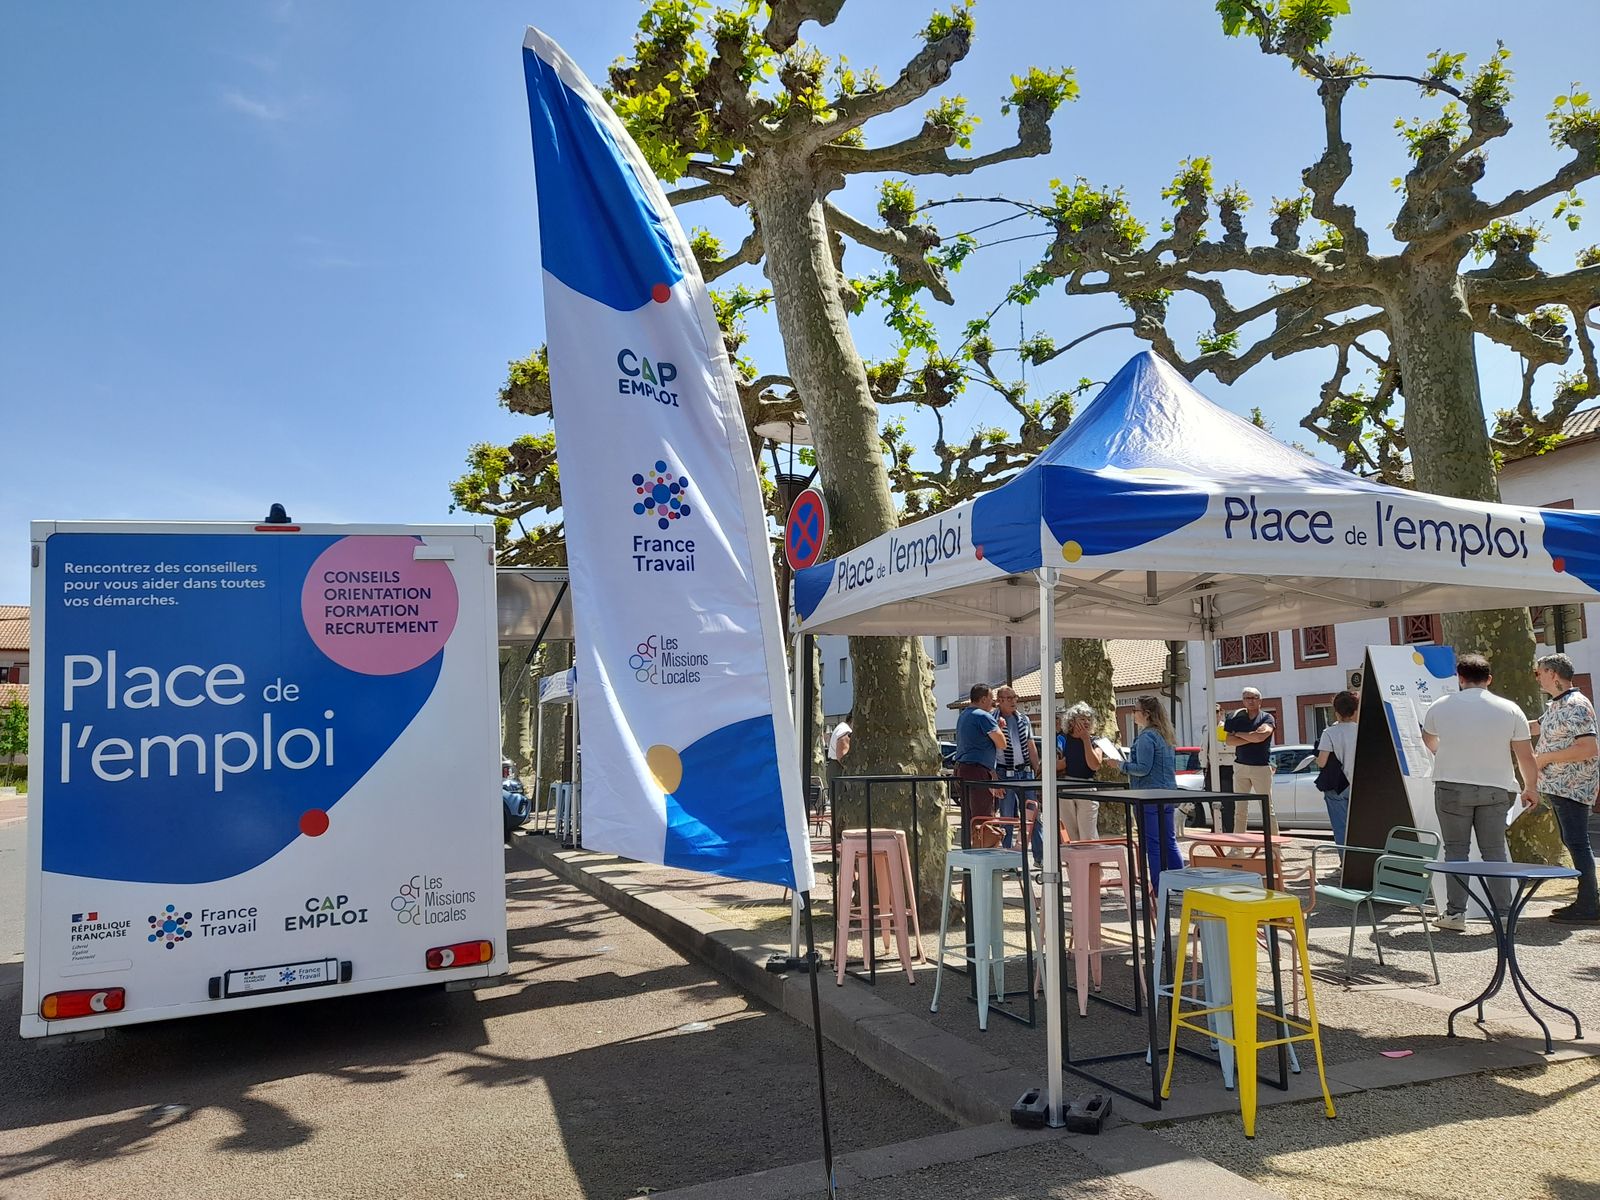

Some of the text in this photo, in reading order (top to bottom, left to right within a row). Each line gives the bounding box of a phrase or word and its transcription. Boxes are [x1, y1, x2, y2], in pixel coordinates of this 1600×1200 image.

[617, 348, 677, 387] CAP
[618, 378, 679, 408] EMPLOI
[1224, 494, 1335, 544] Place
[1344, 525, 1367, 546] de
[633, 535, 695, 553] France
[64, 561, 258, 574] Rencontrez des conseillers
[632, 554, 695, 572] Travail
[323, 570, 401, 584] CONSEILS
[837, 556, 874, 594] Place
[876, 563, 886, 579] de
[63, 577, 266, 593] pour vous aider dans toutes
[63, 593, 180, 607] vos démarches.
[323, 587, 432, 601] ORIENTATION
[324, 604, 419, 618] FORMATION
[325, 620, 439, 635] RECRUTEMENT
[660, 634, 679, 651] Les
[661, 651, 709, 668] Missions
[63, 649, 300, 711] Place de
[661, 669, 701, 685] Locales
[1389, 684, 1405, 692] CAP
[424, 875, 443, 890] Les
[305, 894, 349, 913] CAP
[424, 890, 476, 907] Missions
[201, 906, 258, 922] France
[284, 908, 368, 932] EMPLOI
[424, 907, 467, 925] Locales
[71, 920, 132, 933] RÉPUBLIQUE
[200, 918, 257, 937] Travail
[71, 929, 127, 942] FRANÇAISE
